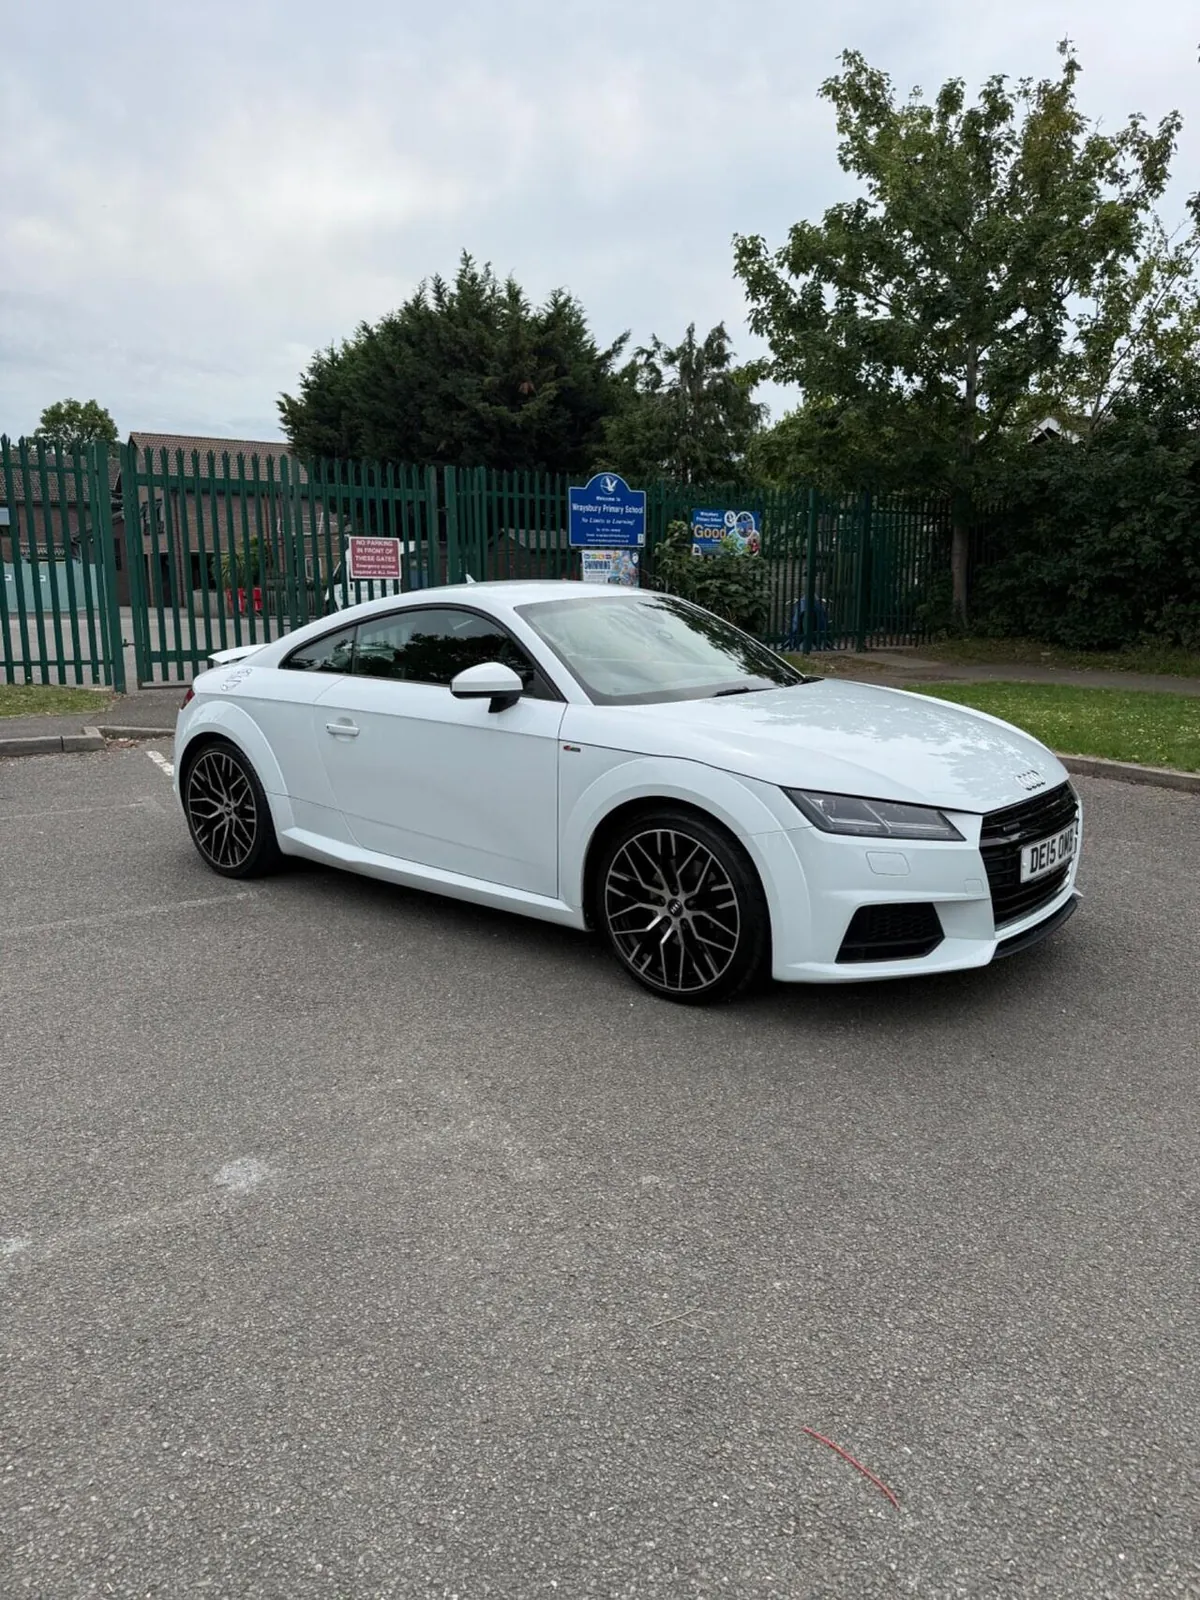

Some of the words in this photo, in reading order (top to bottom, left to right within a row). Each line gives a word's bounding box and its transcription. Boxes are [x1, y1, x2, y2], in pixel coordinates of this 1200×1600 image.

[572, 503, 601, 514] Wraysbury
[602, 504, 624, 514] Primary
[625, 505, 643, 513] School
[694, 524, 726, 538] Good
[1030, 839, 1056, 873] DE15
